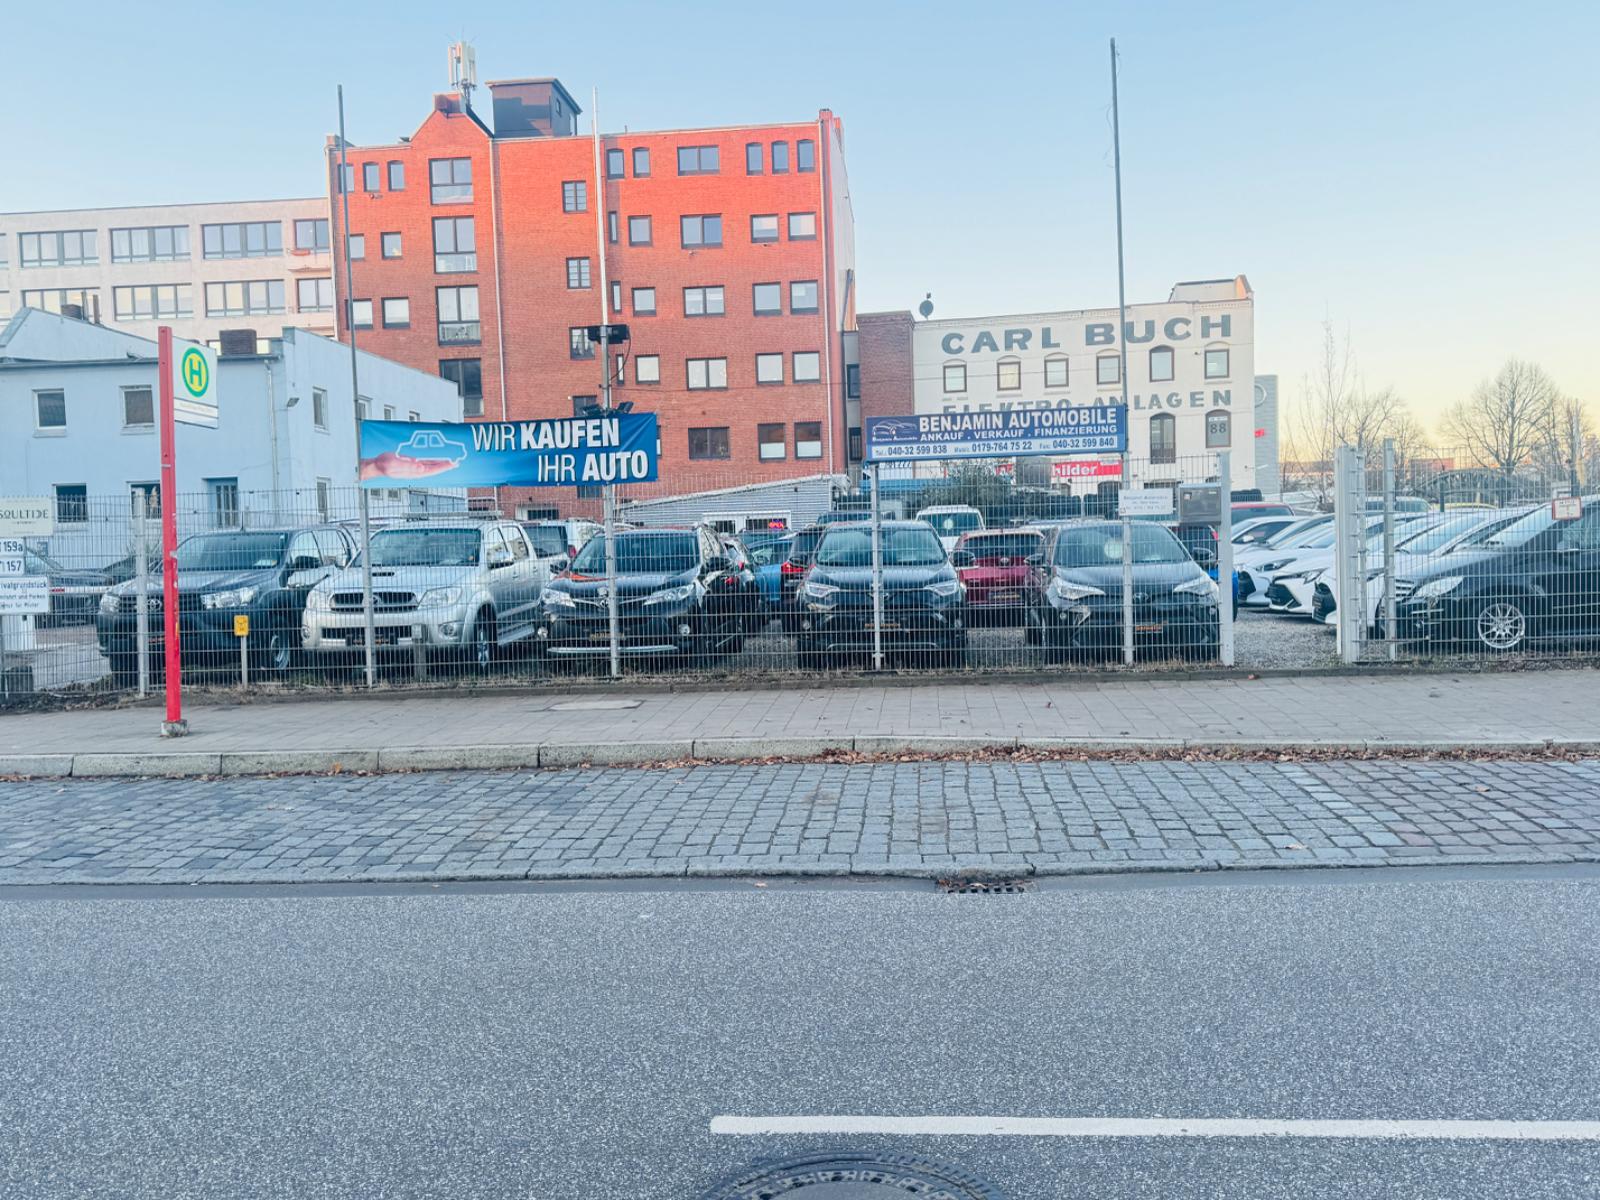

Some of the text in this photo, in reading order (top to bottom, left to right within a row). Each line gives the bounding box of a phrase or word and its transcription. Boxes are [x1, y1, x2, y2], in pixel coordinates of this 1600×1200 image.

[941, 314, 1231, 355] CARL BUCH
[919, 407, 1117, 432] BENJAMIN AUTOMOBILE
[471, 418, 620, 451] WIR KAUFEN
[920, 425, 1117, 442] ANKAUF VERKAUF FINANZIERUNG
[1210, 423, 1227, 434] 88
[971, 441, 1008, 452] 0179-764
[1010, 441, 1020, 450] 75
[1022, 440, 1032, 450] 22
[1052, 439, 1080, 449] 040-32
[1082, 438, 1097, 448] 599
[1099, 437, 1115, 446] 840
[888, 446, 914, 456] 040-32
[916, 445, 931, 455] 599
[932, 445, 948, 454] 838
[538, 450, 648, 482] IHR AUTO
[4, 541, 23, 551] 159a
[7, 560, 21, 571] 157
